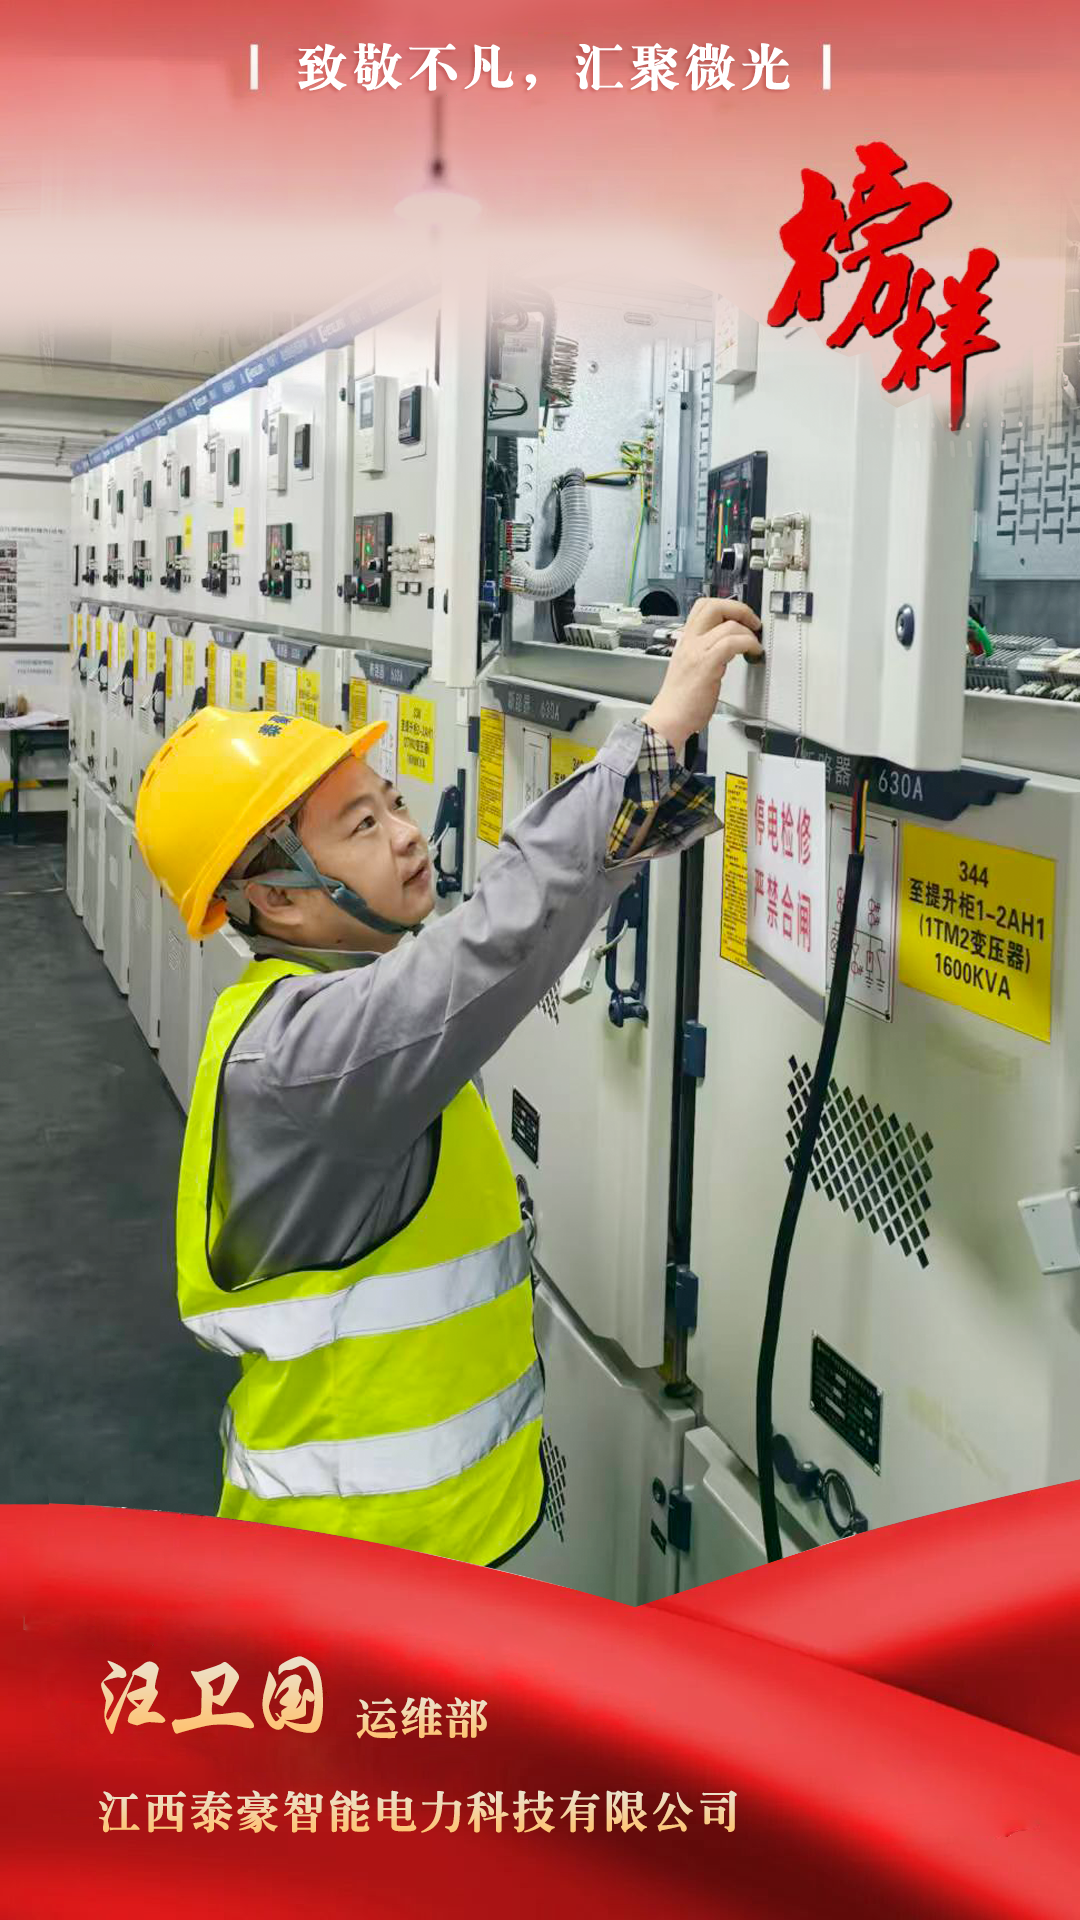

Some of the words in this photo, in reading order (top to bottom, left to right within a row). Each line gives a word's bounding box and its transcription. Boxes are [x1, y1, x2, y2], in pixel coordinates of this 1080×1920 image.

[801, 751, 851, 787] 路器
[878, 769, 924, 802] 630A
[754, 793, 812, 866] 停电检修
[958, 860, 989, 888] 344
[754, 867, 812, 953] 严禁合闸
[908, 877, 1045, 941] 至提升柜1-2AH1
[919, 913, 1031, 974] (1TM2变压器)
[935, 952, 1011, 1000] 1600KVA
